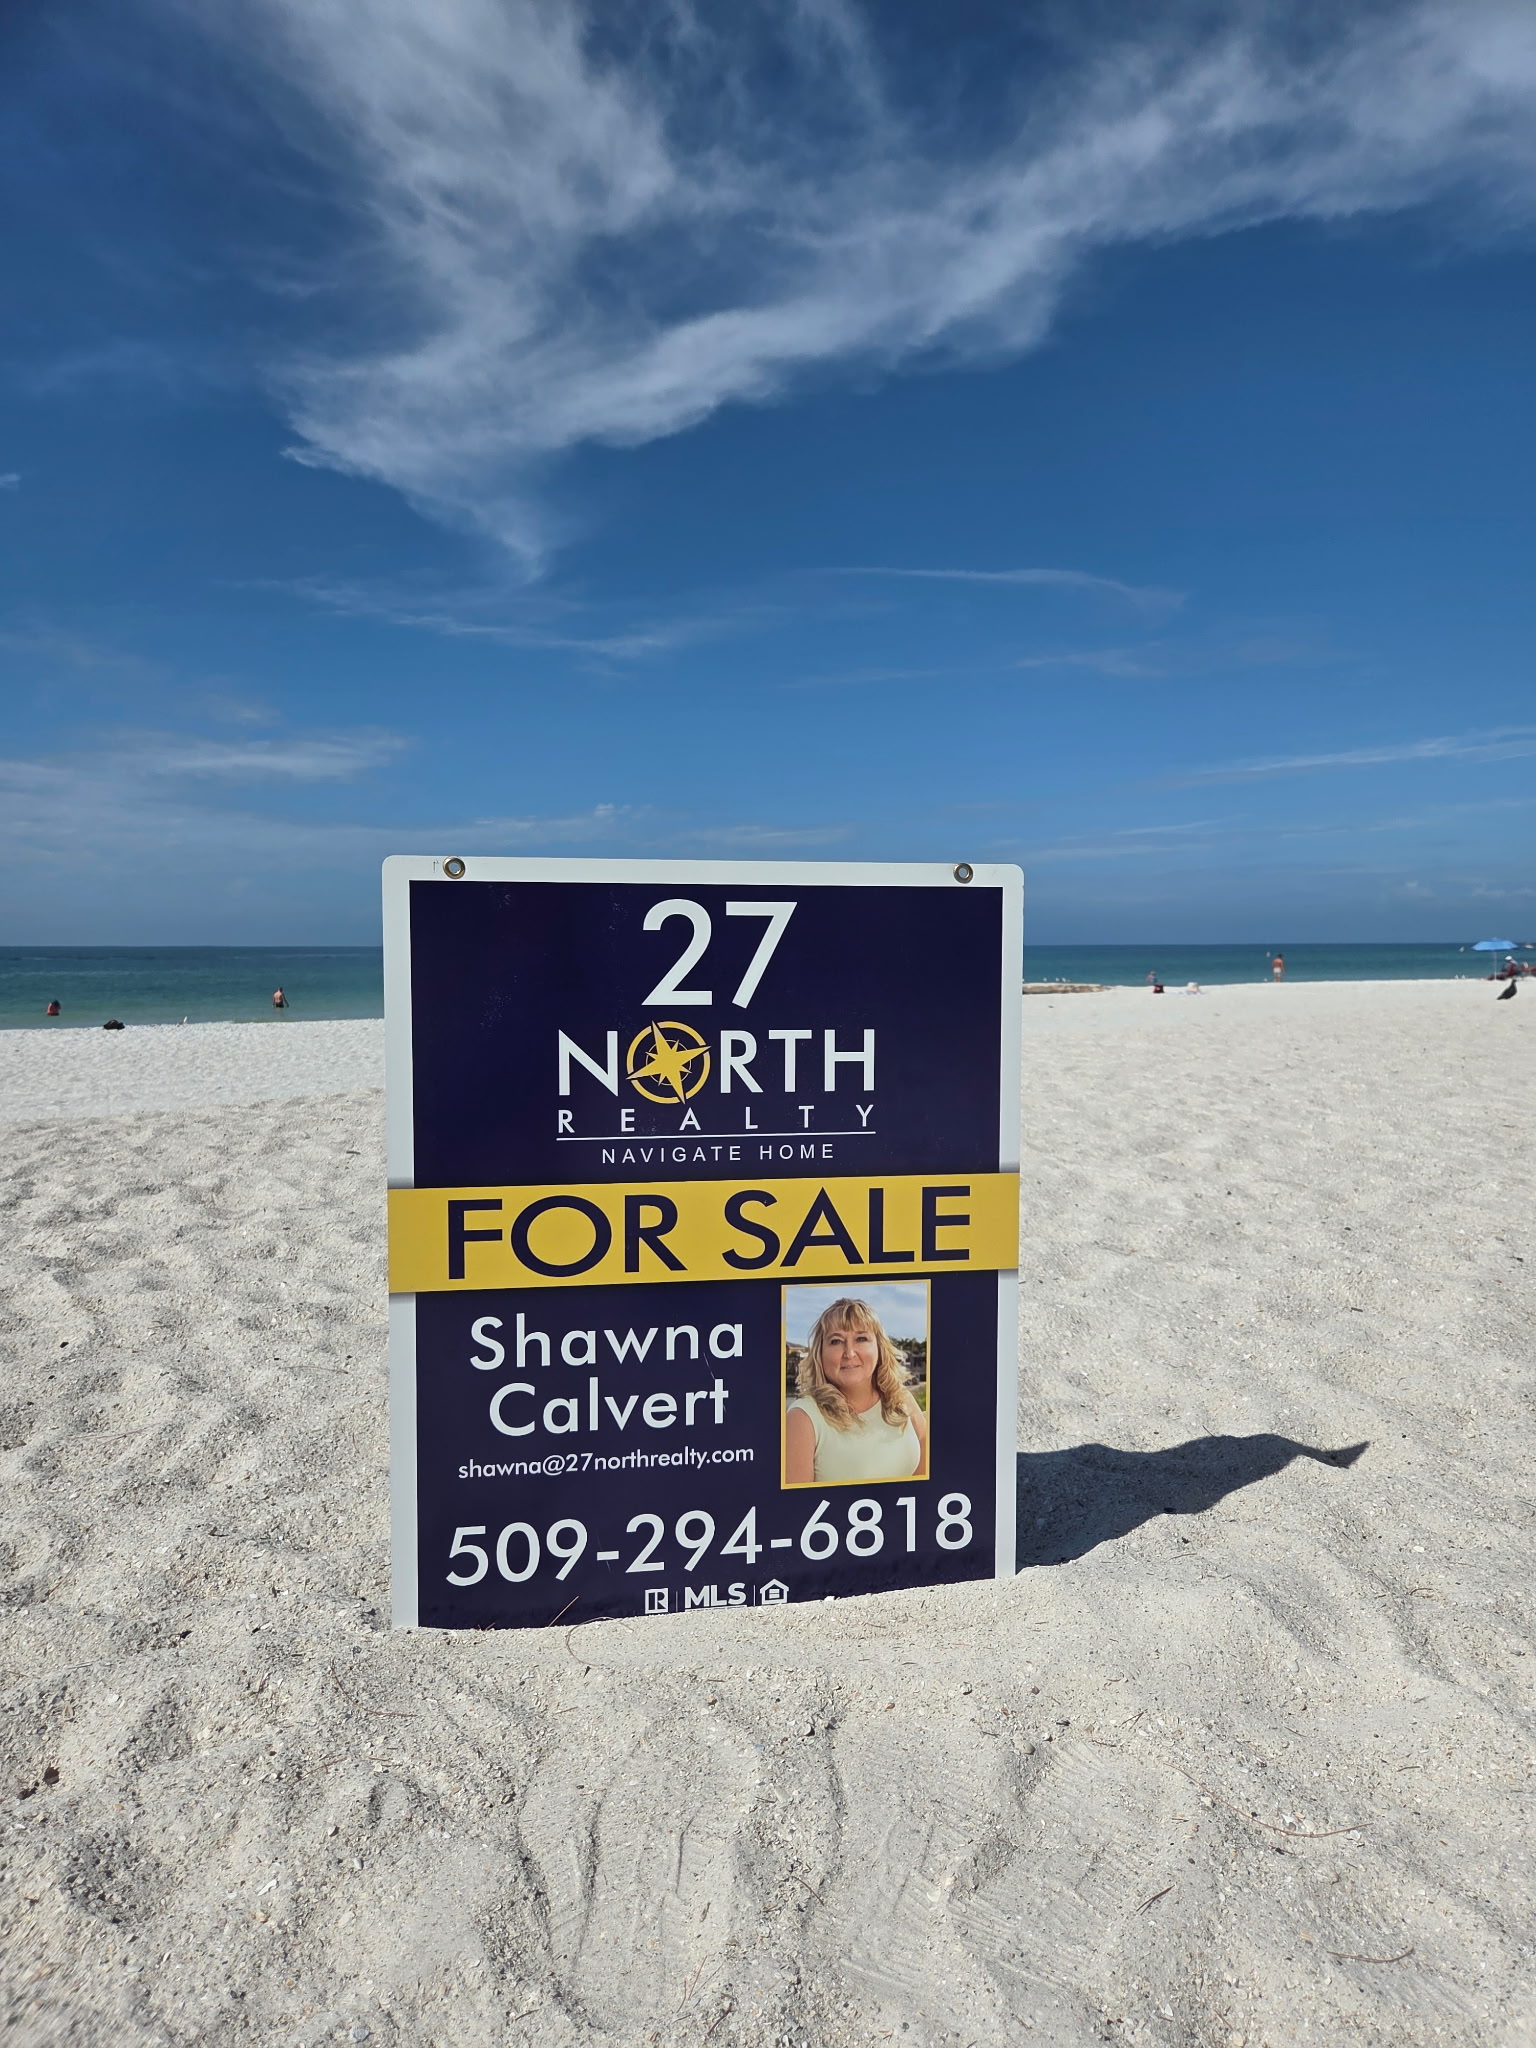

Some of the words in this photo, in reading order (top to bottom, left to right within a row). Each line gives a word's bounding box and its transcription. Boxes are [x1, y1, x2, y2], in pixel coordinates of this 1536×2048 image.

[641, 898, 798, 1009] 27
[558, 1020, 875, 1105] NORTH
[557, 1104, 874, 1134] REALTY
[602, 1145, 742, 1164] NAVIGATE
[759, 1143, 834, 1160] HOME
[448, 1194, 688, 1280] FOR
[721, 1185, 971, 1268] SALE
[469, 1312, 744, 1371] Shawna
[489, 1377, 730, 1437] Calvert
[458, 1445, 754, 1479] shawna@27northrealty.com
[445, 1492, 974, 1587] 509-294-6818
[684, 1582, 747, 1609] MLS
